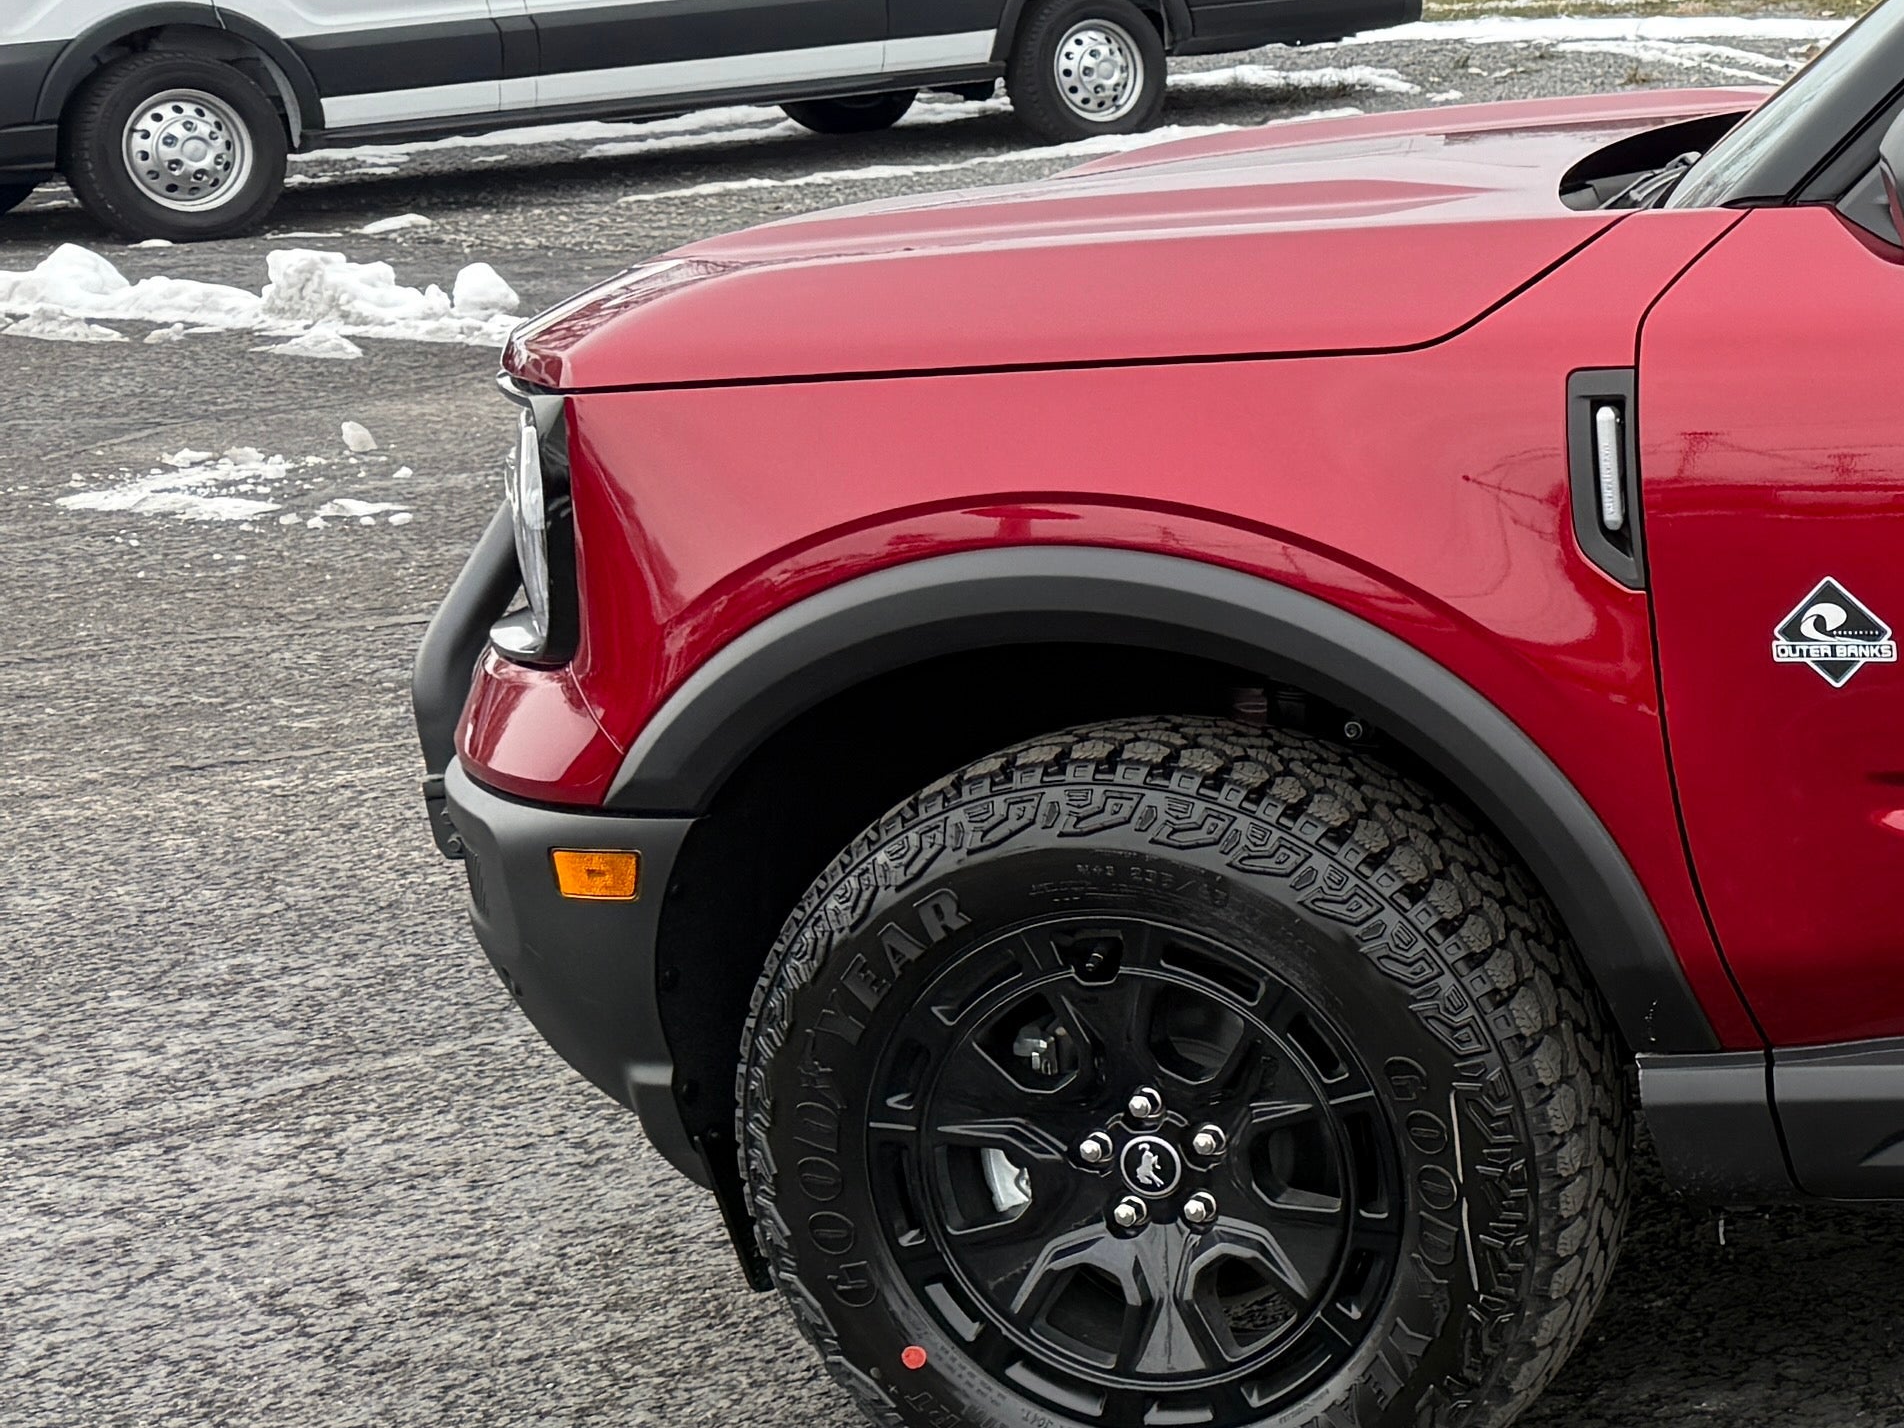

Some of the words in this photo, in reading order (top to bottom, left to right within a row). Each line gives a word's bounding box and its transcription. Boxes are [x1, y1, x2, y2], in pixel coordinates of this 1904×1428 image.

[1777, 644, 1832, 658] OUTER
[1836, 644, 1893, 658] BANKS
[794, 887, 973, 1308] GOODYEAR
